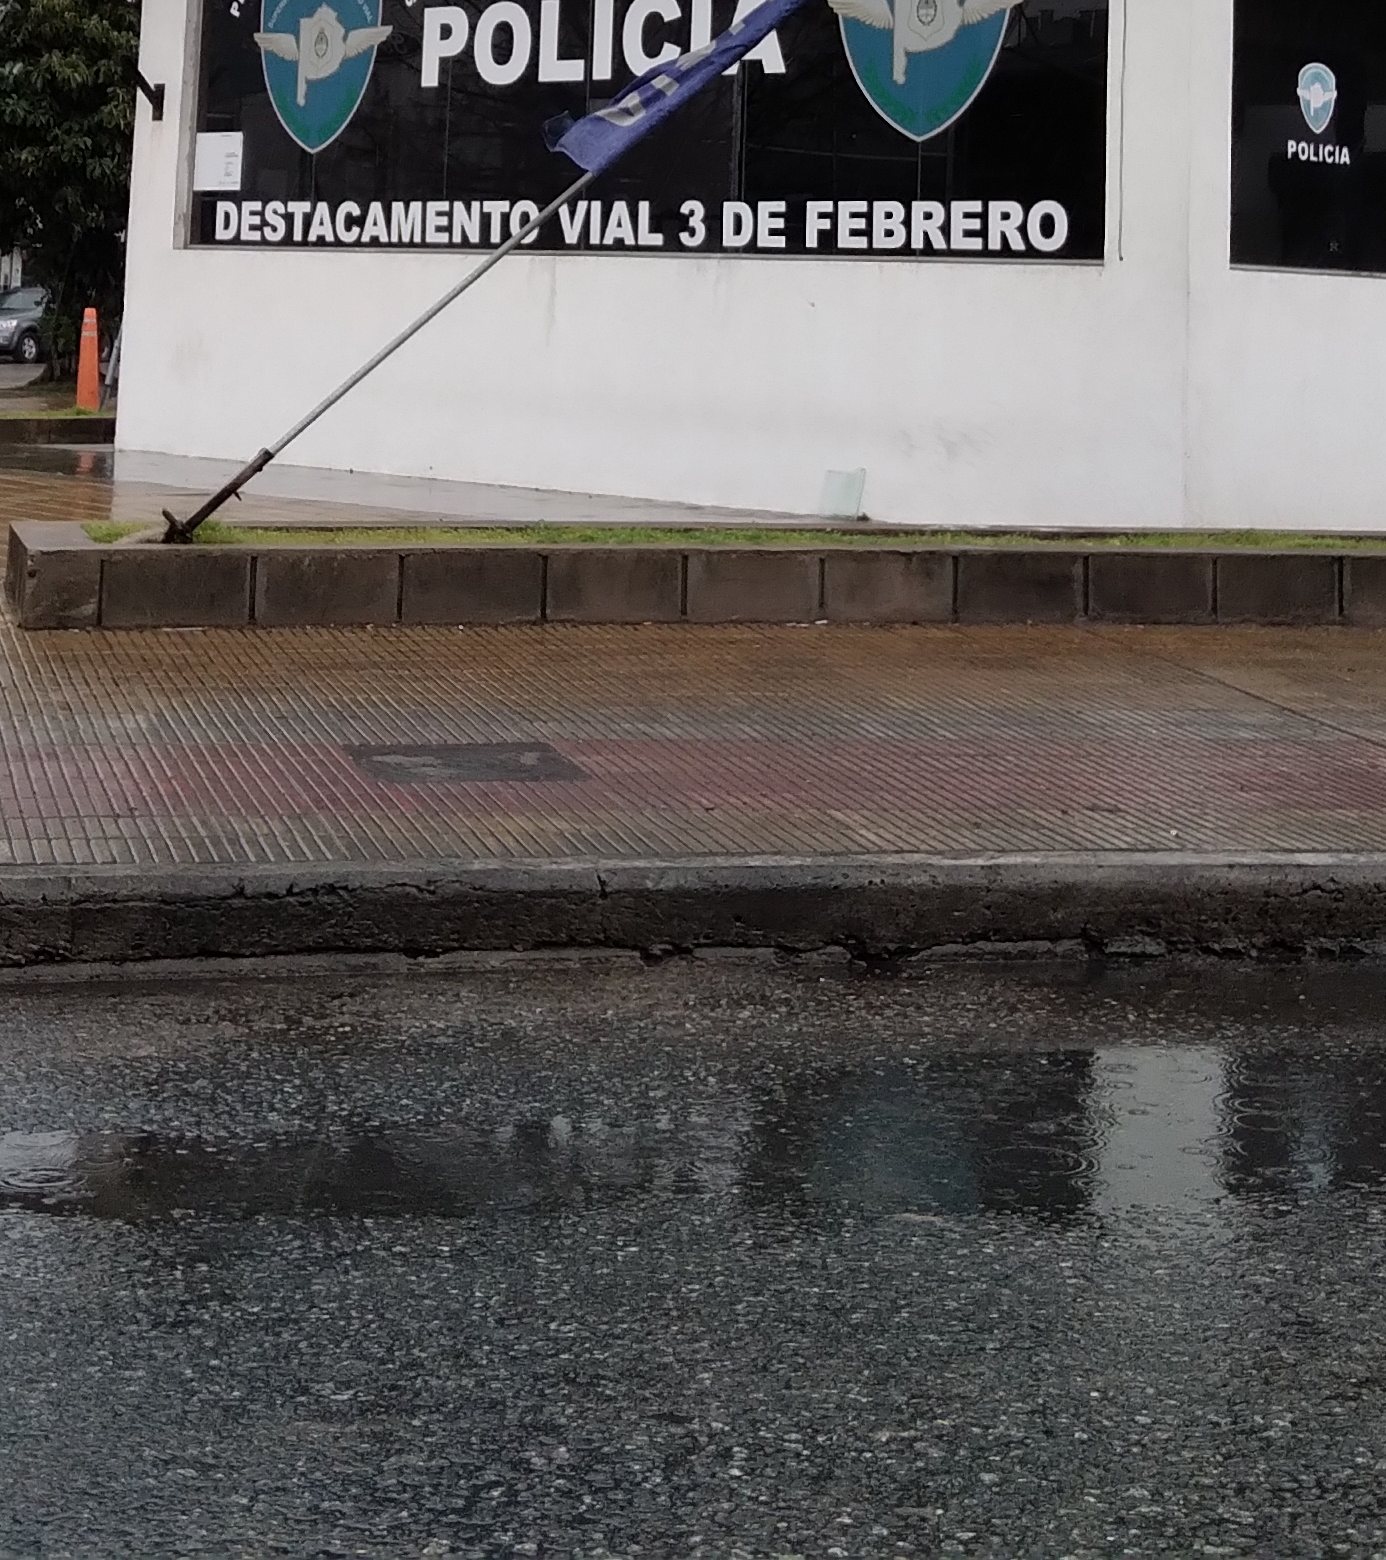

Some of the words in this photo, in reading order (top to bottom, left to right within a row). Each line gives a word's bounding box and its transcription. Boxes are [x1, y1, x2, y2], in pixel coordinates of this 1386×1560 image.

[1287, 139, 1351, 166] POLICIA
[214, 200, 540, 244] DESTACAMENTO
[558, 200, 664, 246] VIAL
[678, 200, 707, 248] 3
[722, 200, 787, 248] DE
[805, 199, 1069, 252] FEBRERO
